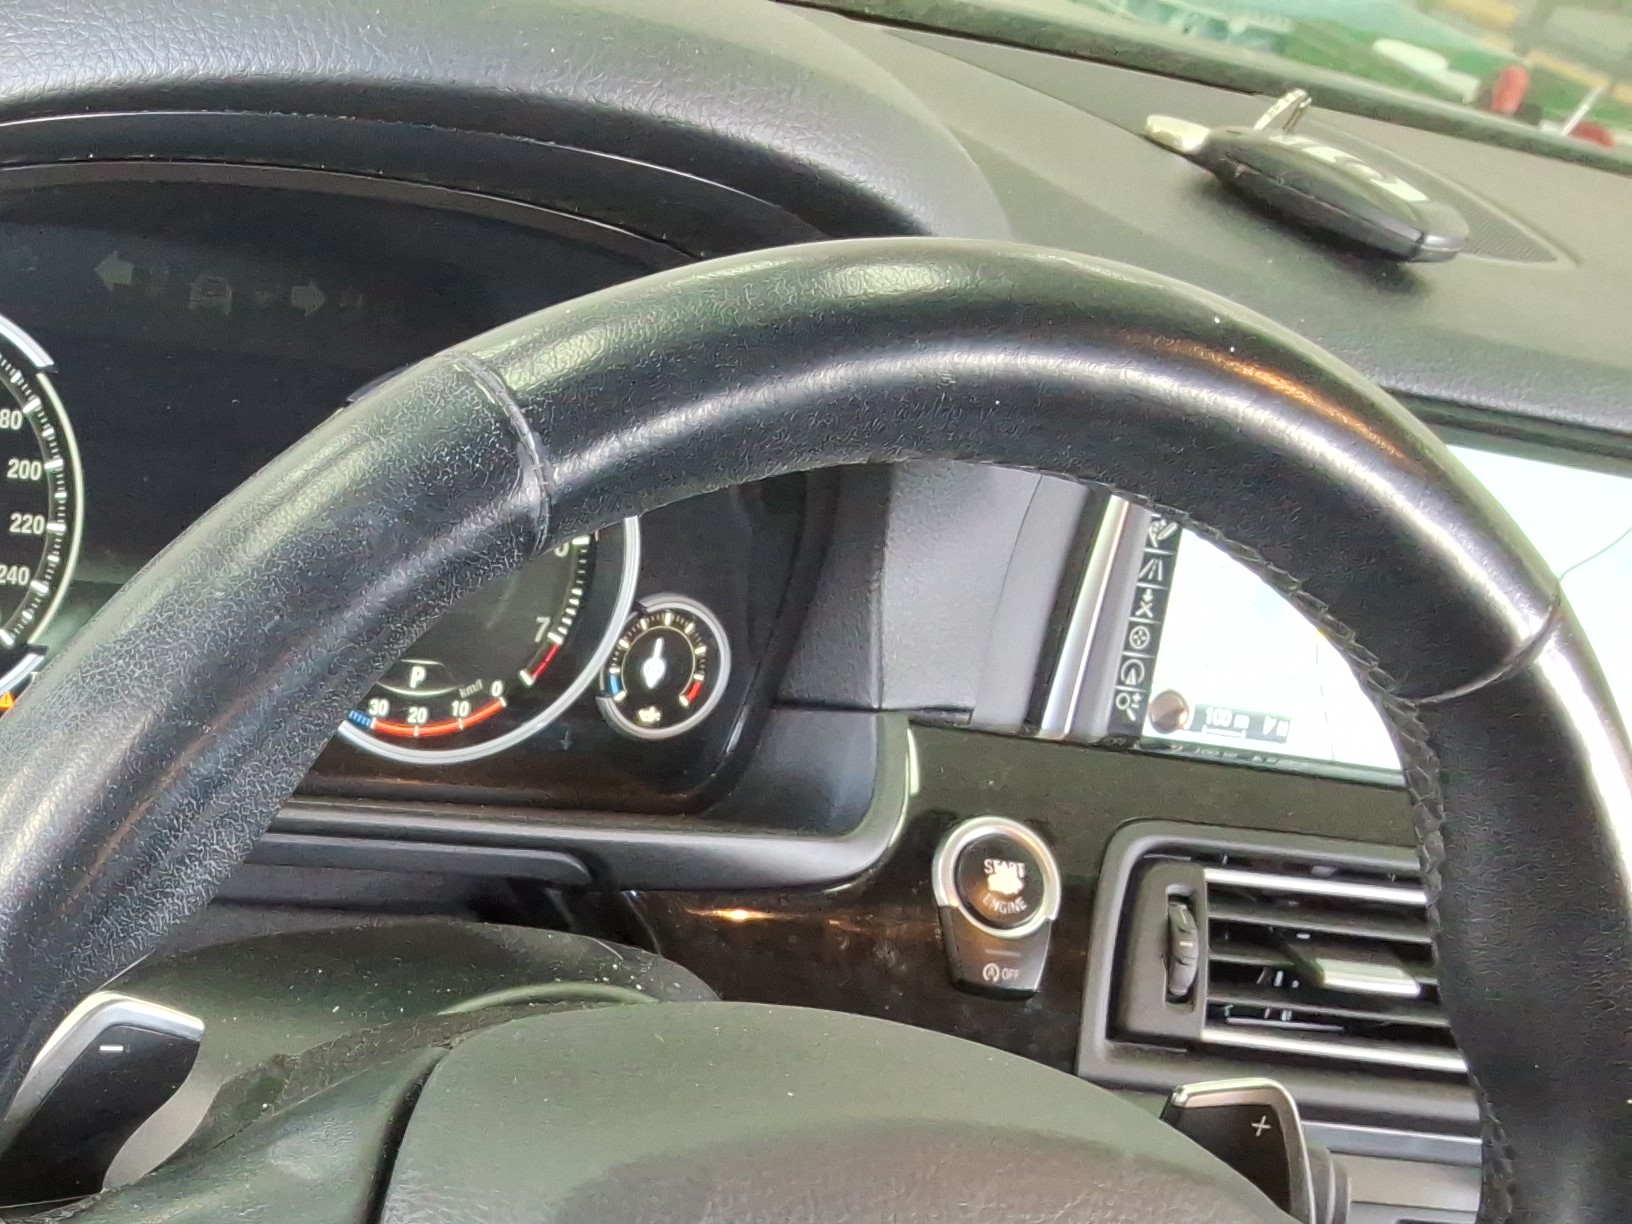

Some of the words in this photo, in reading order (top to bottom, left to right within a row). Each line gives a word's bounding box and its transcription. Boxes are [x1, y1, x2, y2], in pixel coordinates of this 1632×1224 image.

[6, 458, 42, 481] 200
[9, 513, 46, 535] 220
[534, 616, 551, 643] 7
[409, 665, 426, 689] P
[490, 680, 504, 698] 0
[368, 698, 390, 716] 30
[407, 706, 429, 724] 20
[450, 700, 470, 718] 10
[984, 858, 1026, 879] START
